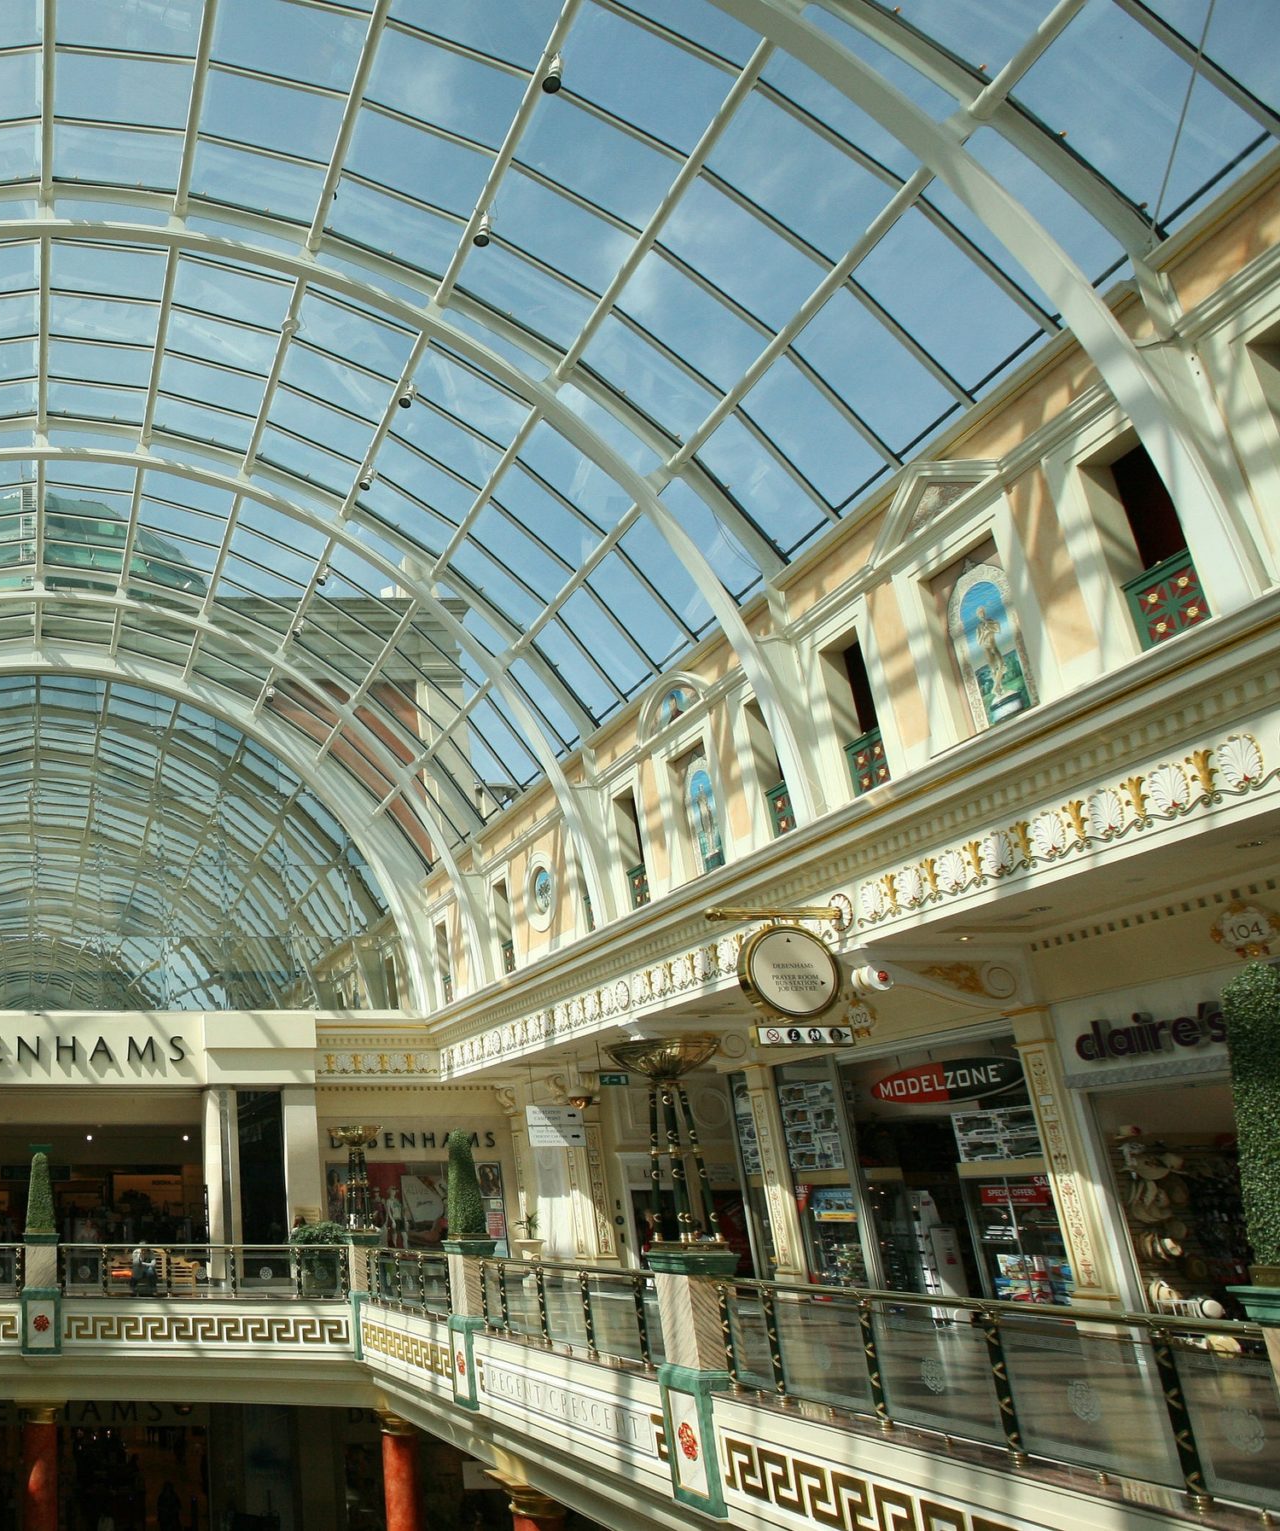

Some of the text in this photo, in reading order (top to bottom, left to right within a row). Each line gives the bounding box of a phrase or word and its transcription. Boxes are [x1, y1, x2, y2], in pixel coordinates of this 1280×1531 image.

[1230, 921, 1264, 940] 104
[851, 1012, 868, 1025] 102
[1076, 1001, 1227, 1060] claire's
[879, 1064, 1002, 1098] MODELZONE
[1033, 1176, 1051, 1186] SAL
[491, 1369, 638, 1440] REGENT CRESCENT
